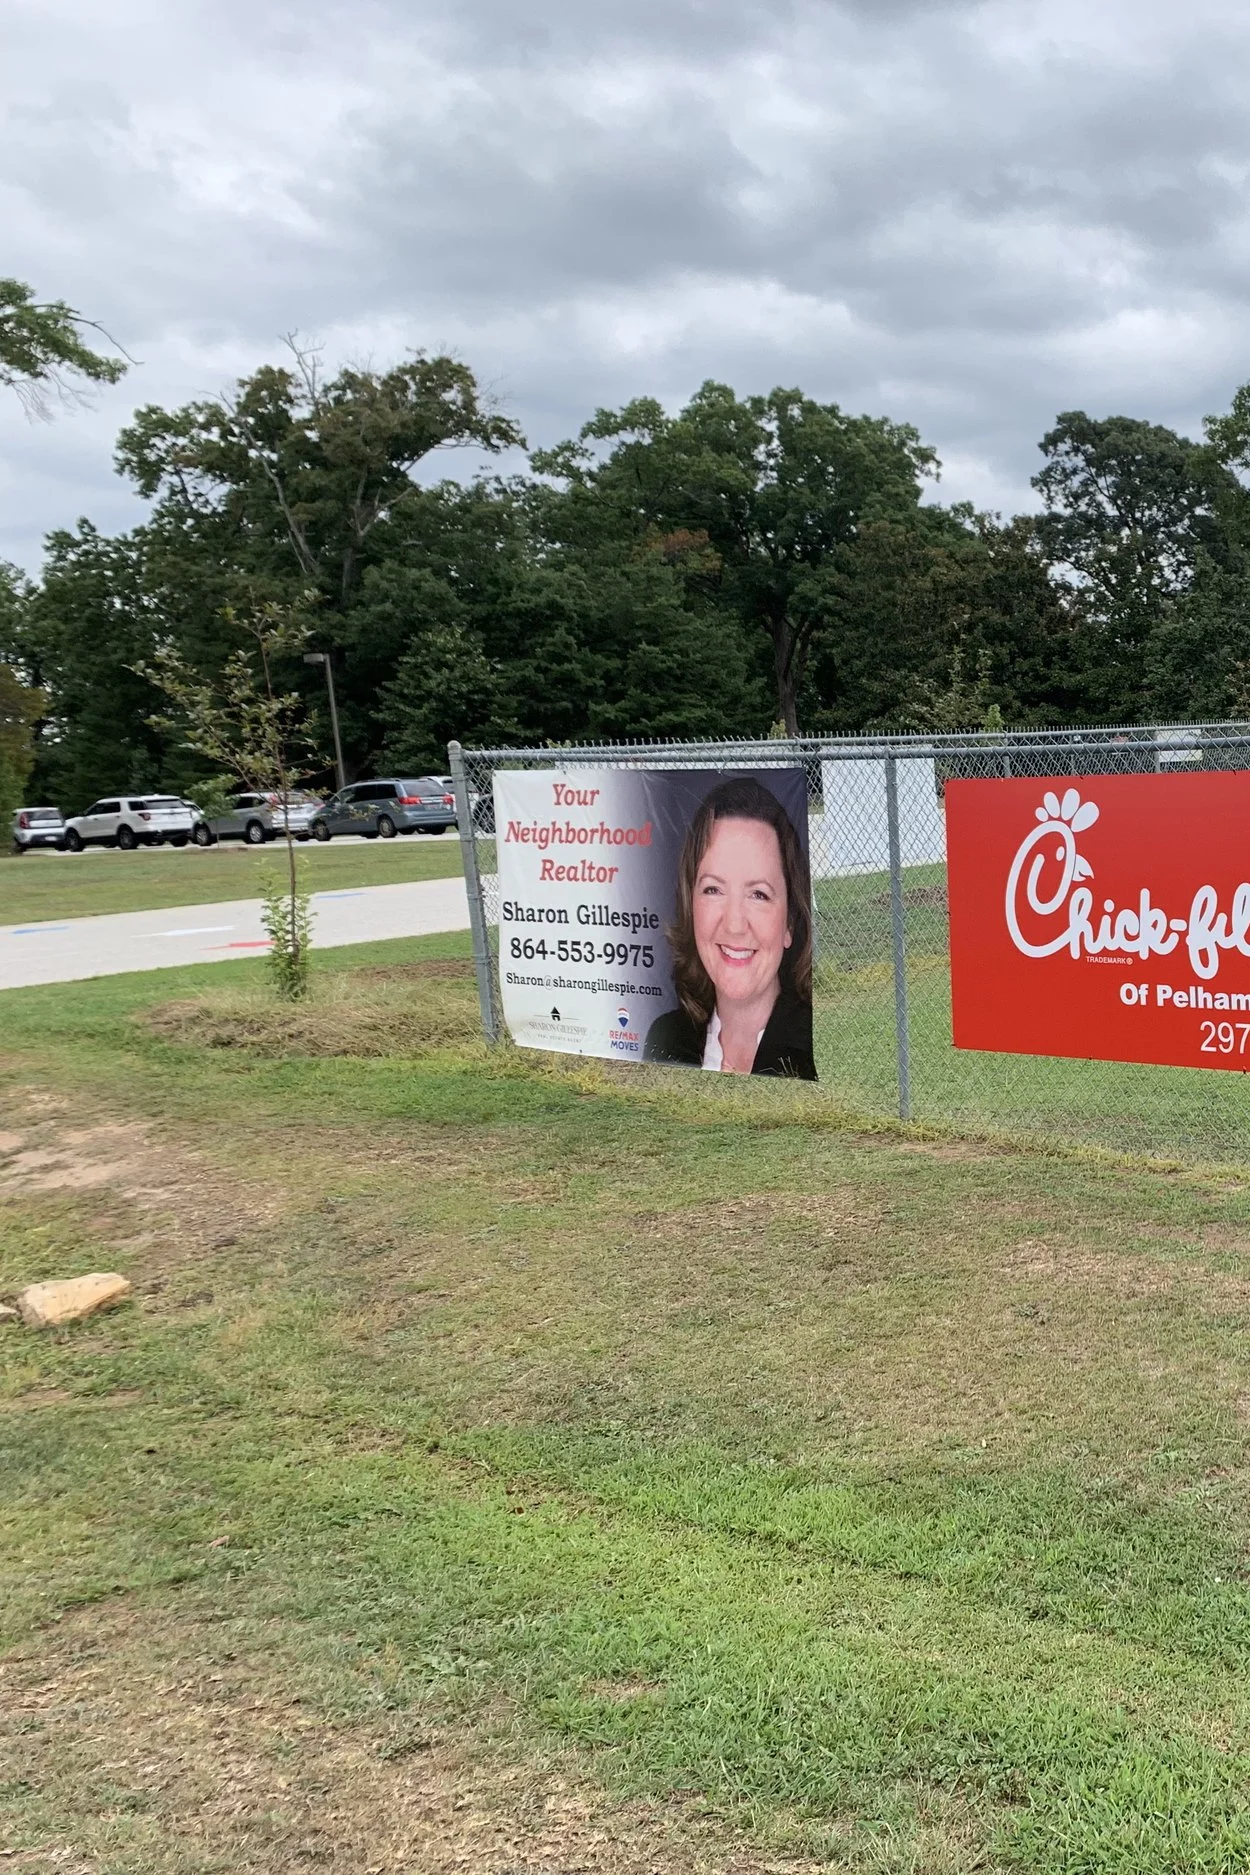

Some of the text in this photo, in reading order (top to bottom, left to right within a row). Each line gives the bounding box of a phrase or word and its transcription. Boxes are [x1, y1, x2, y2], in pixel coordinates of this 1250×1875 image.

[553, 783, 599, 806] Your
[505, 821, 651, 850] Neighborhood
[540, 859, 618, 883] Realtor
[502, 902, 659, 934] Sharon Gillespie
[510, 937, 655, 968] 864-553-9975
[506, 972, 662, 997] Sharon@sharongillespie.com
[1119, 983, 1149, 1006] Of
[609, 1030, 639, 1041] RE/MAX
[610, 1040, 639, 1052] MOVES
